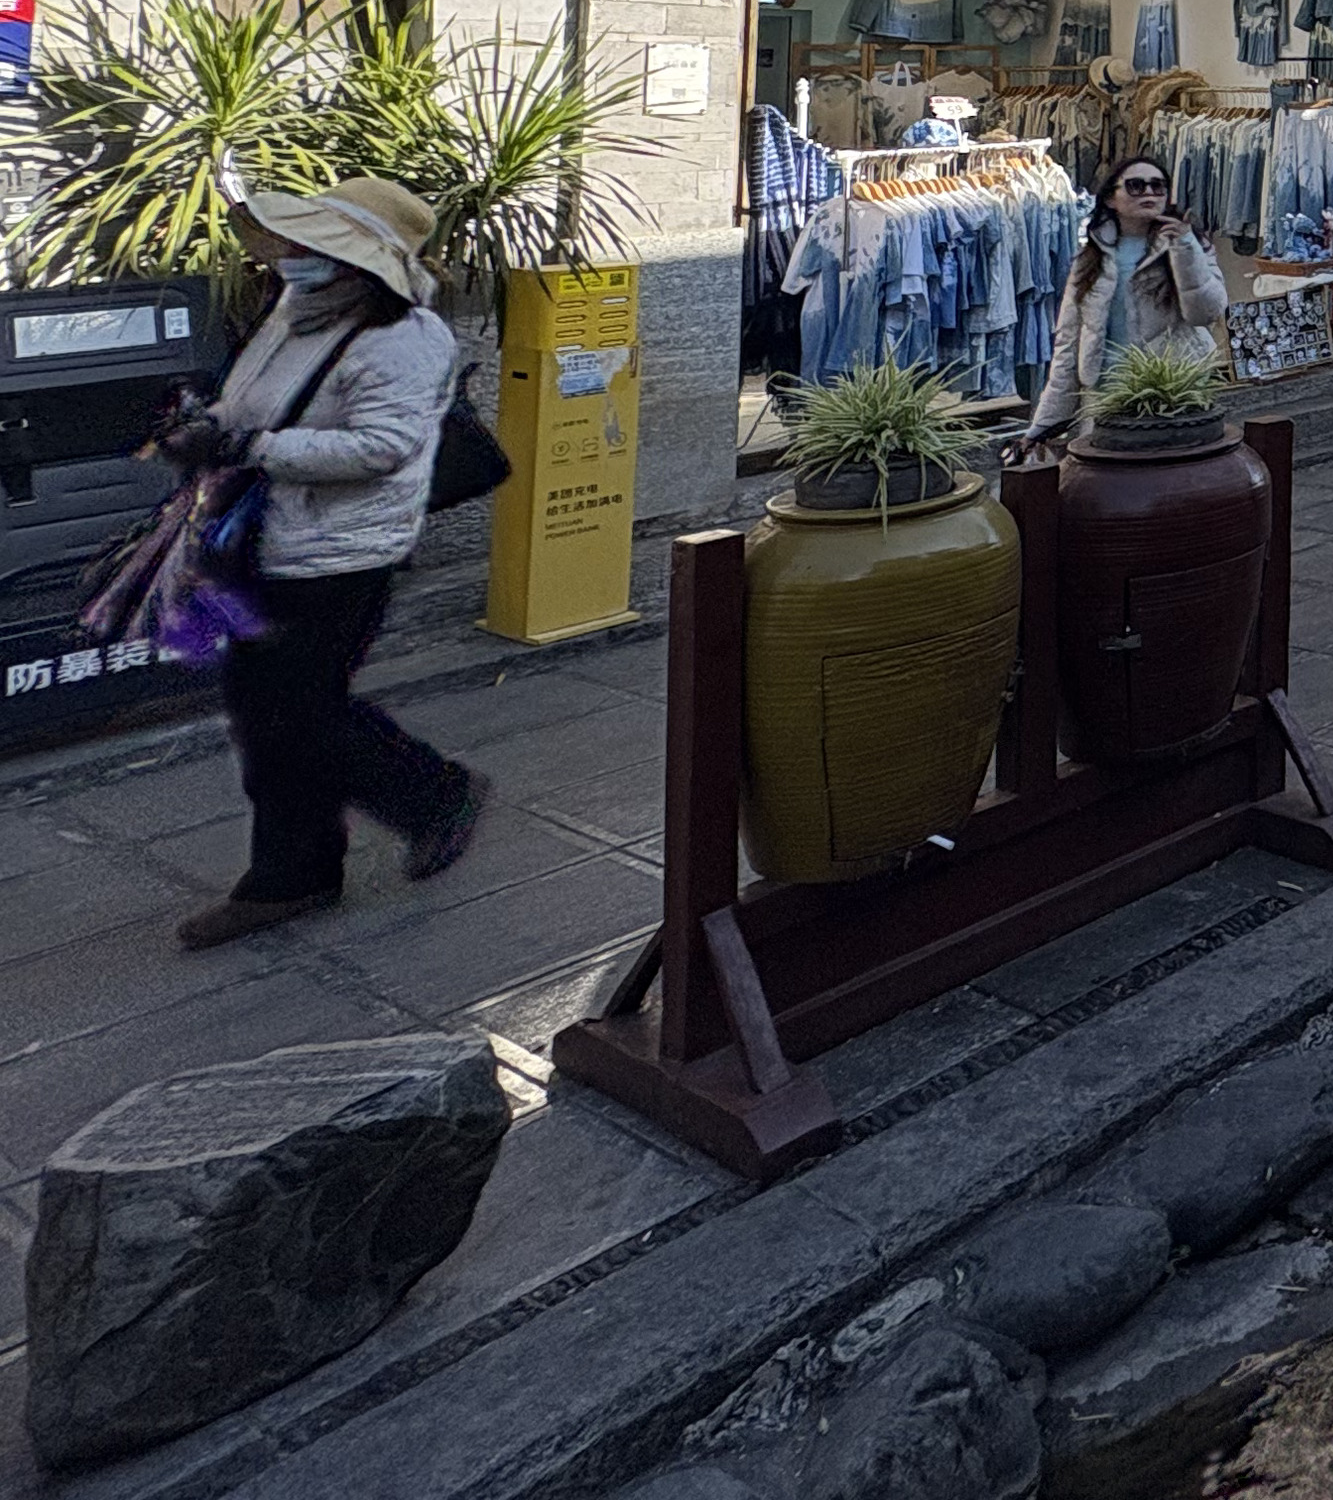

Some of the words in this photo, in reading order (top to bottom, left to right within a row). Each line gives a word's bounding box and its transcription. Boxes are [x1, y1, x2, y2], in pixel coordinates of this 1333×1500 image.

[547, 484, 598, 501] 美团充电
[546, 494, 622, 516] 给生活加满电
[6, 638, 183, 697] 防暴装
